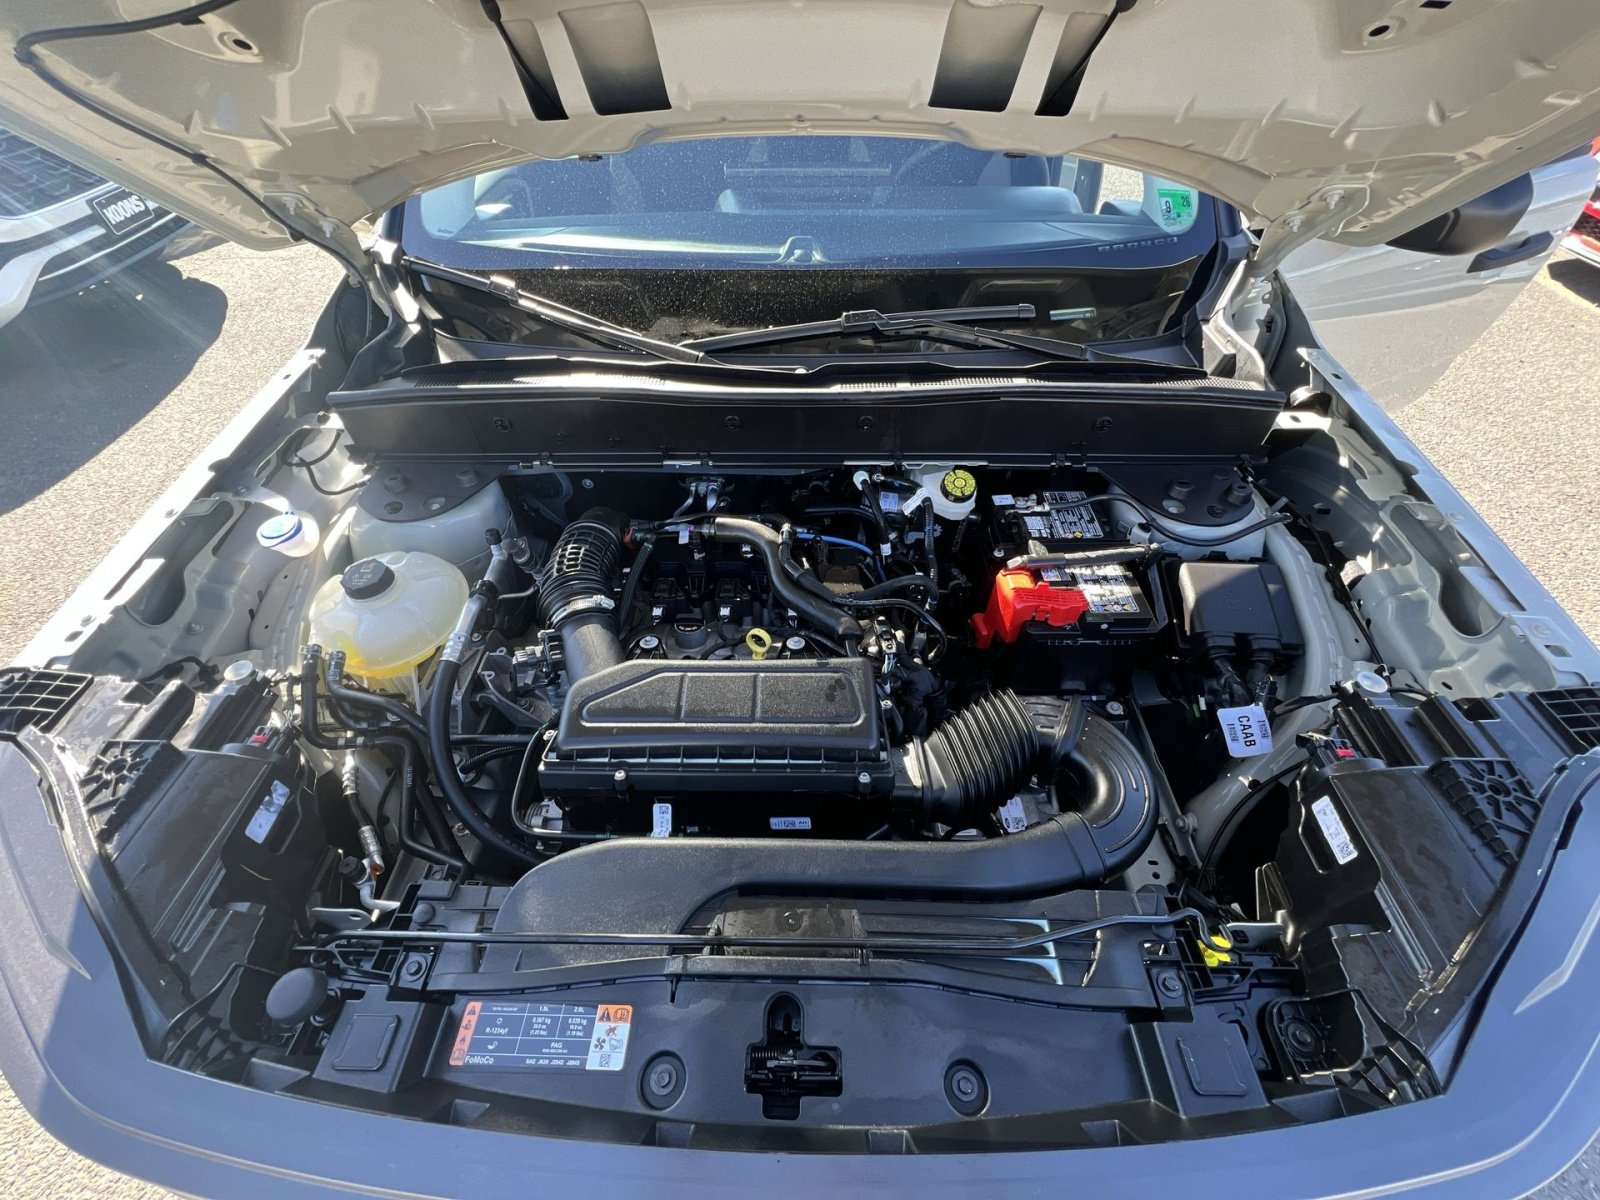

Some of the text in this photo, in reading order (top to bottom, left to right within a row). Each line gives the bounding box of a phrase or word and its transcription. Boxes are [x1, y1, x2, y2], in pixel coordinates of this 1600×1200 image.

[103, 194, 146, 225] KOONS
[1237, 715, 1257, 747] CAAB
[485, 1026, 509, 1035] R-1234yf
[550, 1041, 563, 1049] PAG
[464, 1055, 495, 1064] FoMoCo
